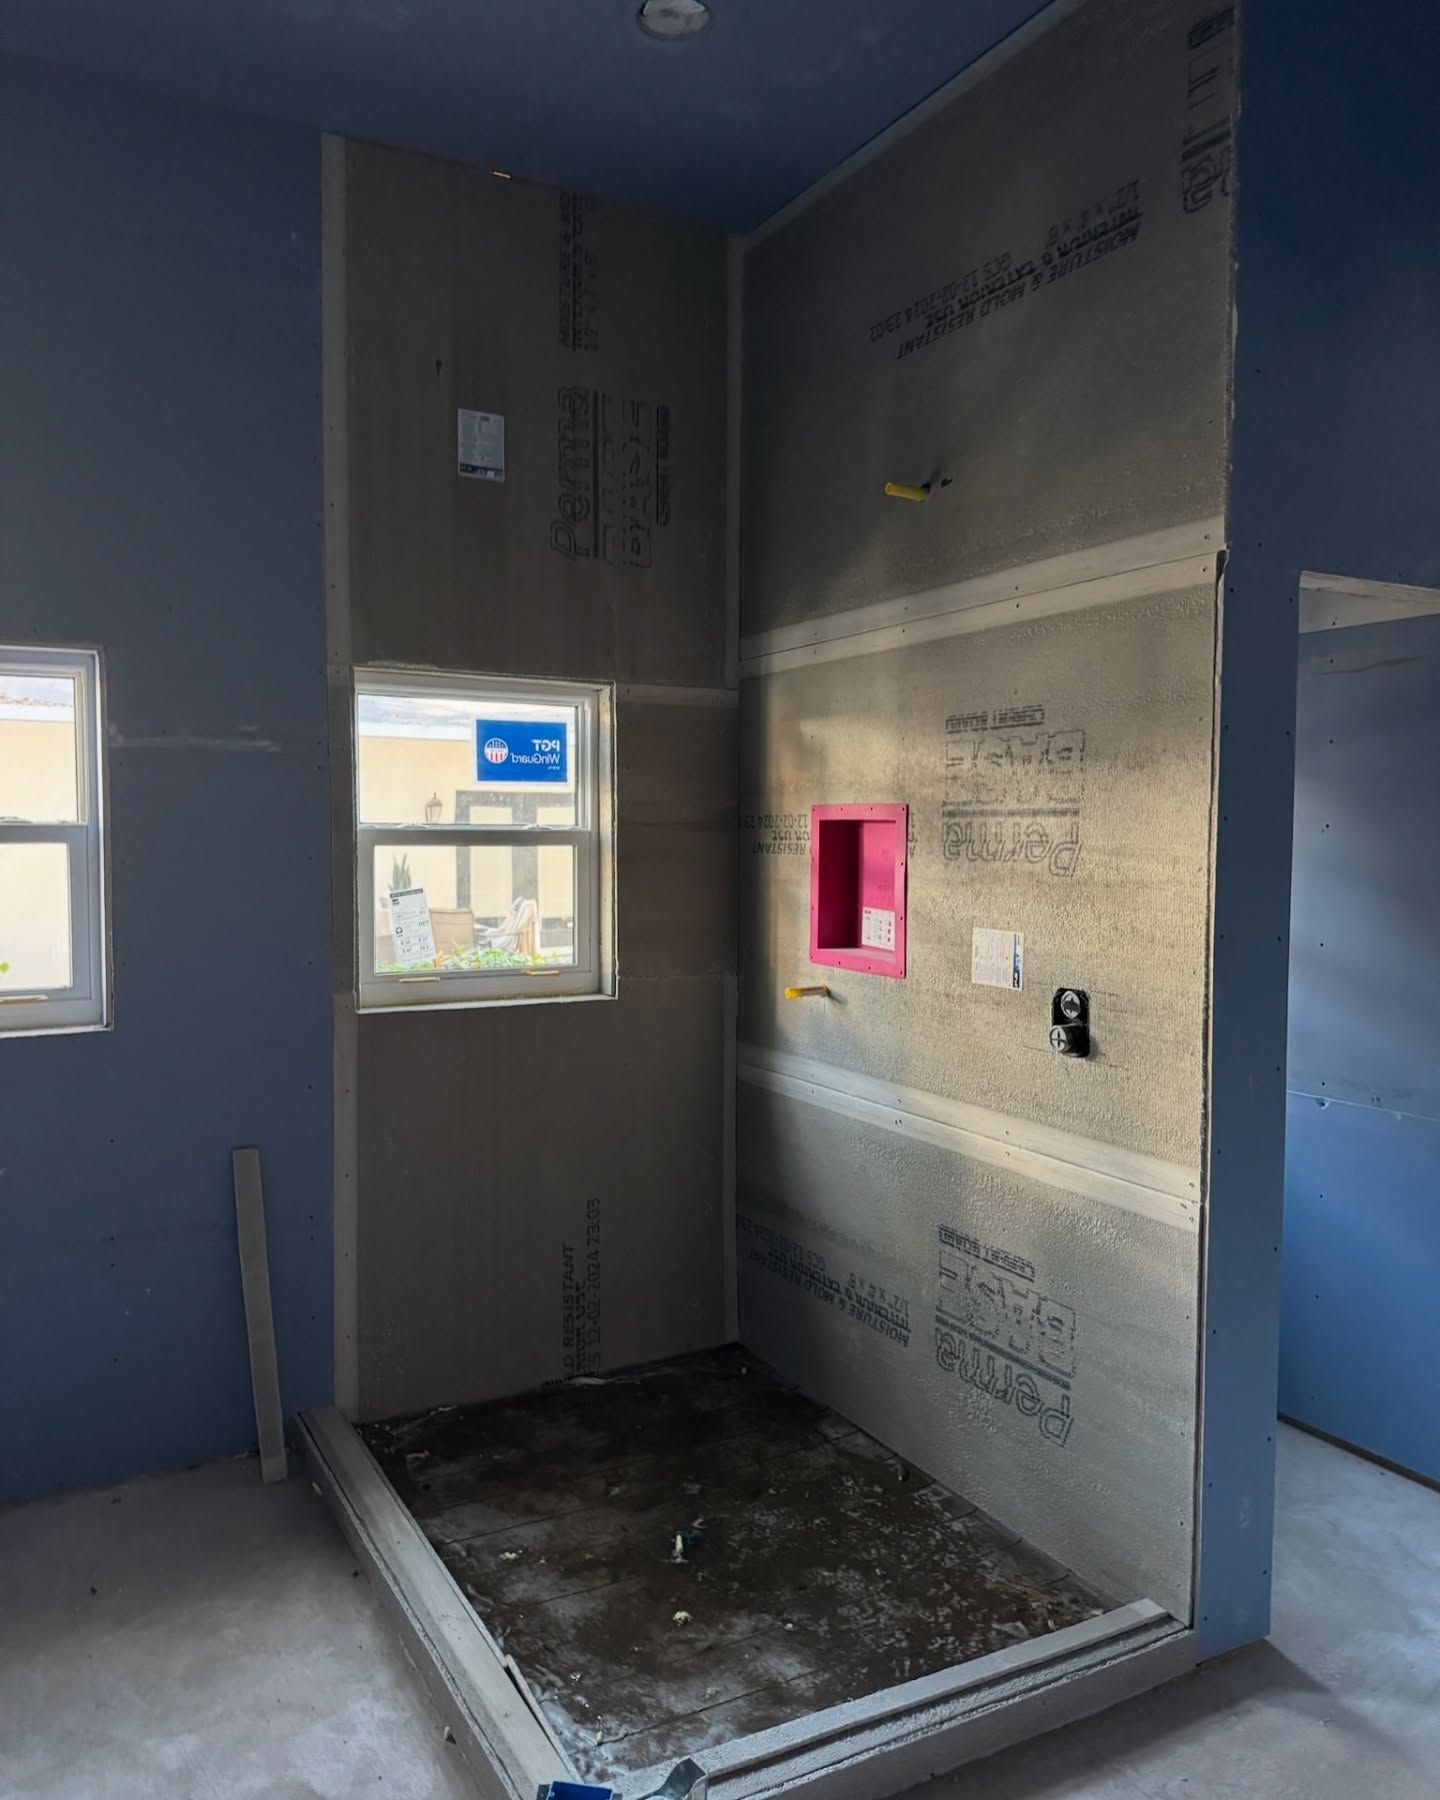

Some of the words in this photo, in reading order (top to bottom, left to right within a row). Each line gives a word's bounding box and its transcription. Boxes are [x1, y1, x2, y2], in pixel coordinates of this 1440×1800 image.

[752, 841, 807, 856] RESISTANT
[941, 821, 1083, 878] Perma
[561, 1242, 576, 1349] RESISTANT
[848, 1302, 911, 1348] MOISTURE
[934, 1326, 1074, 1448] Perma
